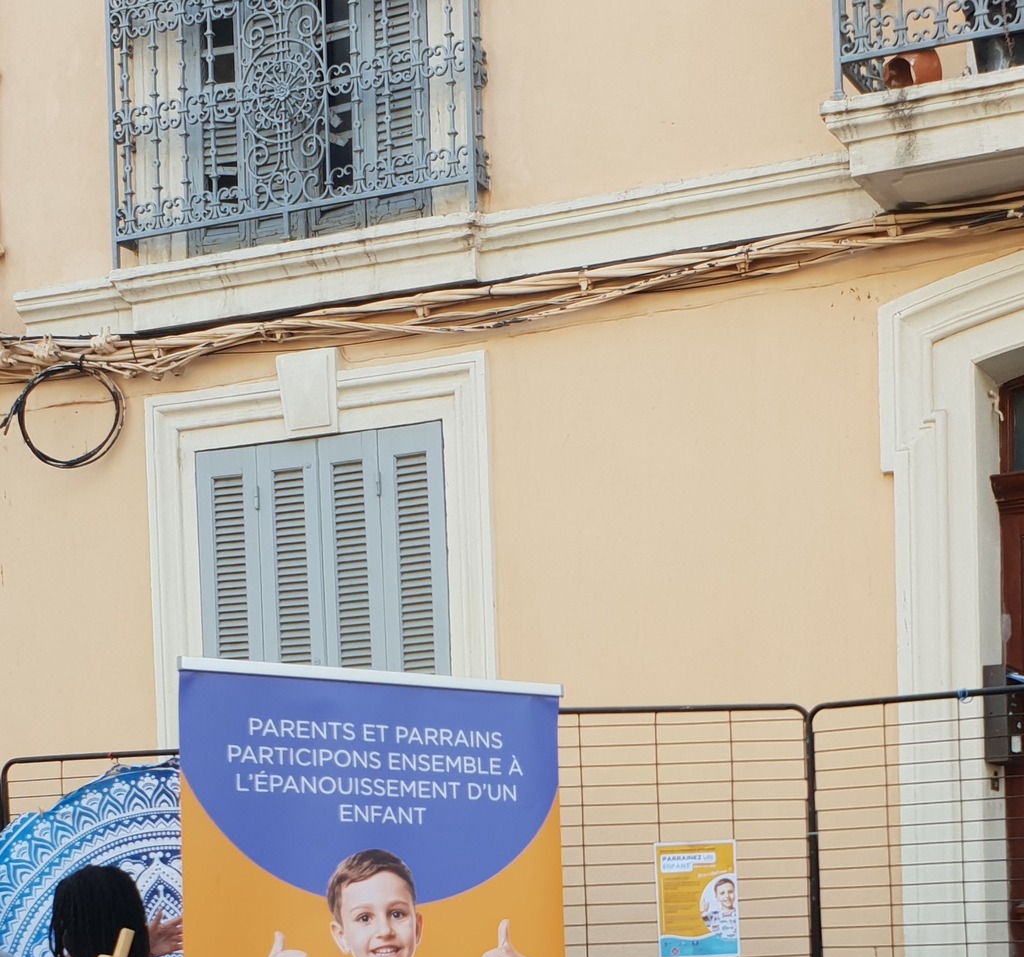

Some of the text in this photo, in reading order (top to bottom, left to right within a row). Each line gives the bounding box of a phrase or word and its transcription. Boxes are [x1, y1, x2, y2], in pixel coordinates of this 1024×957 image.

[248, 717, 503, 749] PARENTS ET PARRAINS
[227, 744, 523, 777] PARTICIPONS ENSEMBLE À
[236, 770, 517, 802] L'ÉPANOUISSEMENT D'UN
[339, 804, 426, 825] ENFANT
